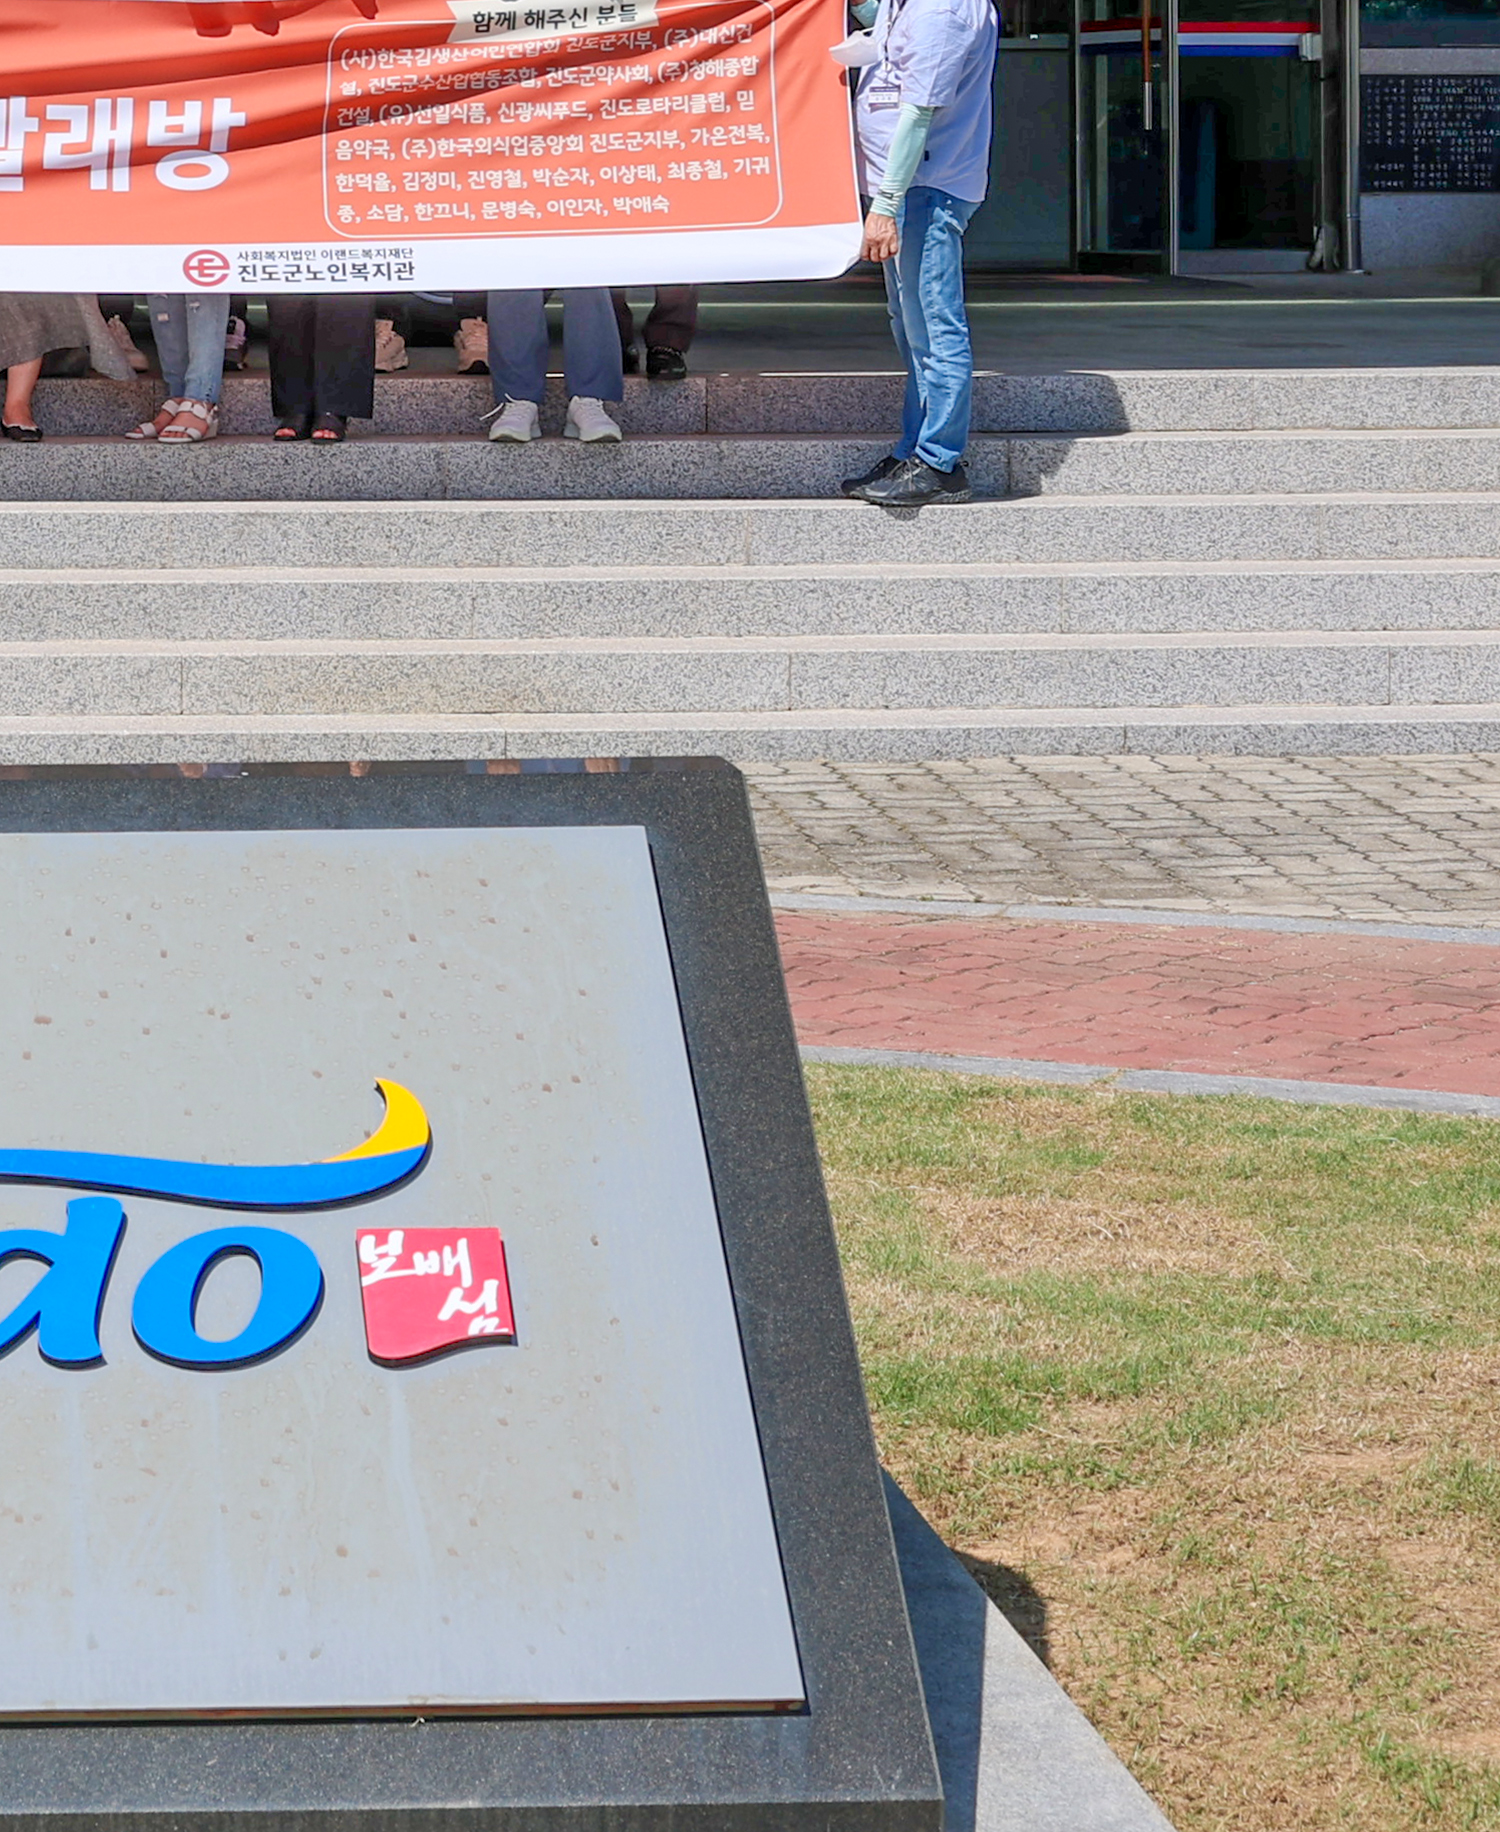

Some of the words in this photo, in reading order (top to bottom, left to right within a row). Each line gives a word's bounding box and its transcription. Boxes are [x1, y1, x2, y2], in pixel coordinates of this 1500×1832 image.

[473, 11, 517, 33] 함께
[524, 8, 588, 31] 해주신
[596, 3, 639, 25] 분들
[498, 100, 593, 121] 신광씨푸드,
[600, 92, 731, 120] 진도로타리클럽,
[335, 138, 396, 161] 음약국,
[401, 134, 584, 160] (주)한국외식업중앙회
[590, 130, 686, 154] 진도군지부,
[691, 123, 771, 147] 가온전복,
[402, 171, 462, 192] 김정미,
[533, 167, 595, 187] 박순자,
[600, 163, 662, 185] 이상태,
[667, 159, 728, 181] 최종철,
[366, 204, 409, 223] 소담,
[481, 200, 542, 220] 문병숙,
[546, 198, 608, 217] 이인자,
[613, 194, 670, 214] 박애숙
[238, 249, 316, 261] 사회복지법인
[321, 248, 414, 260] 이랜드복지재단
[238, 260, 415, 283] 진도군노인복지관
